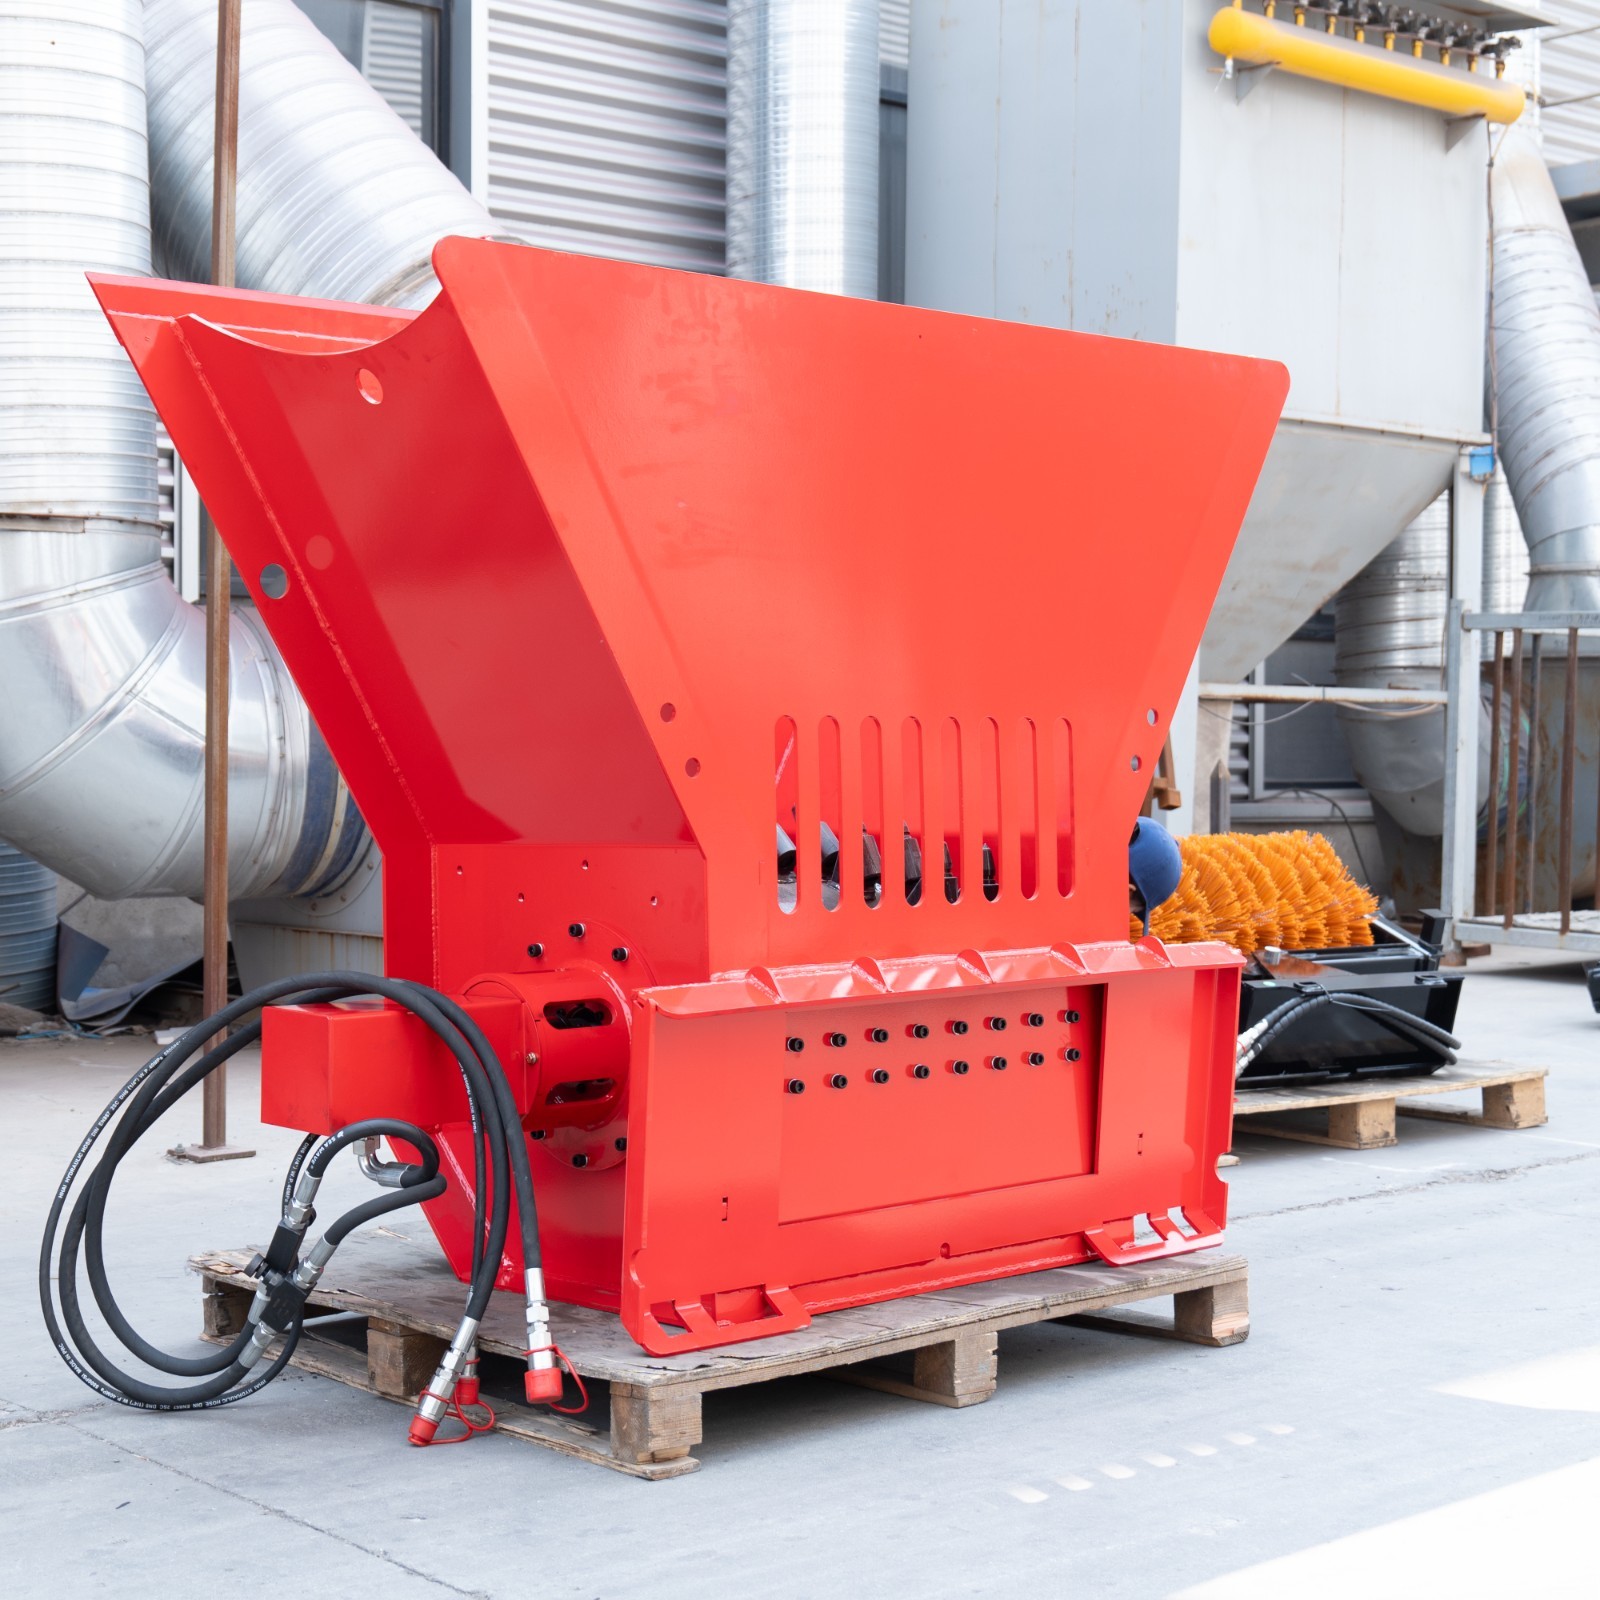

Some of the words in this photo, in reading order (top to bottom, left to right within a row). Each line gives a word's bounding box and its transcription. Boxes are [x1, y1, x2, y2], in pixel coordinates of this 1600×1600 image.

[324, 1136, 336, 1148] SEA
[65, 1152, 83, 1183] HYDRAULIC
[81, 1138, 92, 1153] HOSE
[91, 1126, 99, 1137] DIN
[311, 1146, 325, 1165] WAVE
[69, 1359, 82, 1374] MADE
[205, 1399, 221, 1407] HOSE
[222, 1389, 253, 1403] HYDRAULIC
